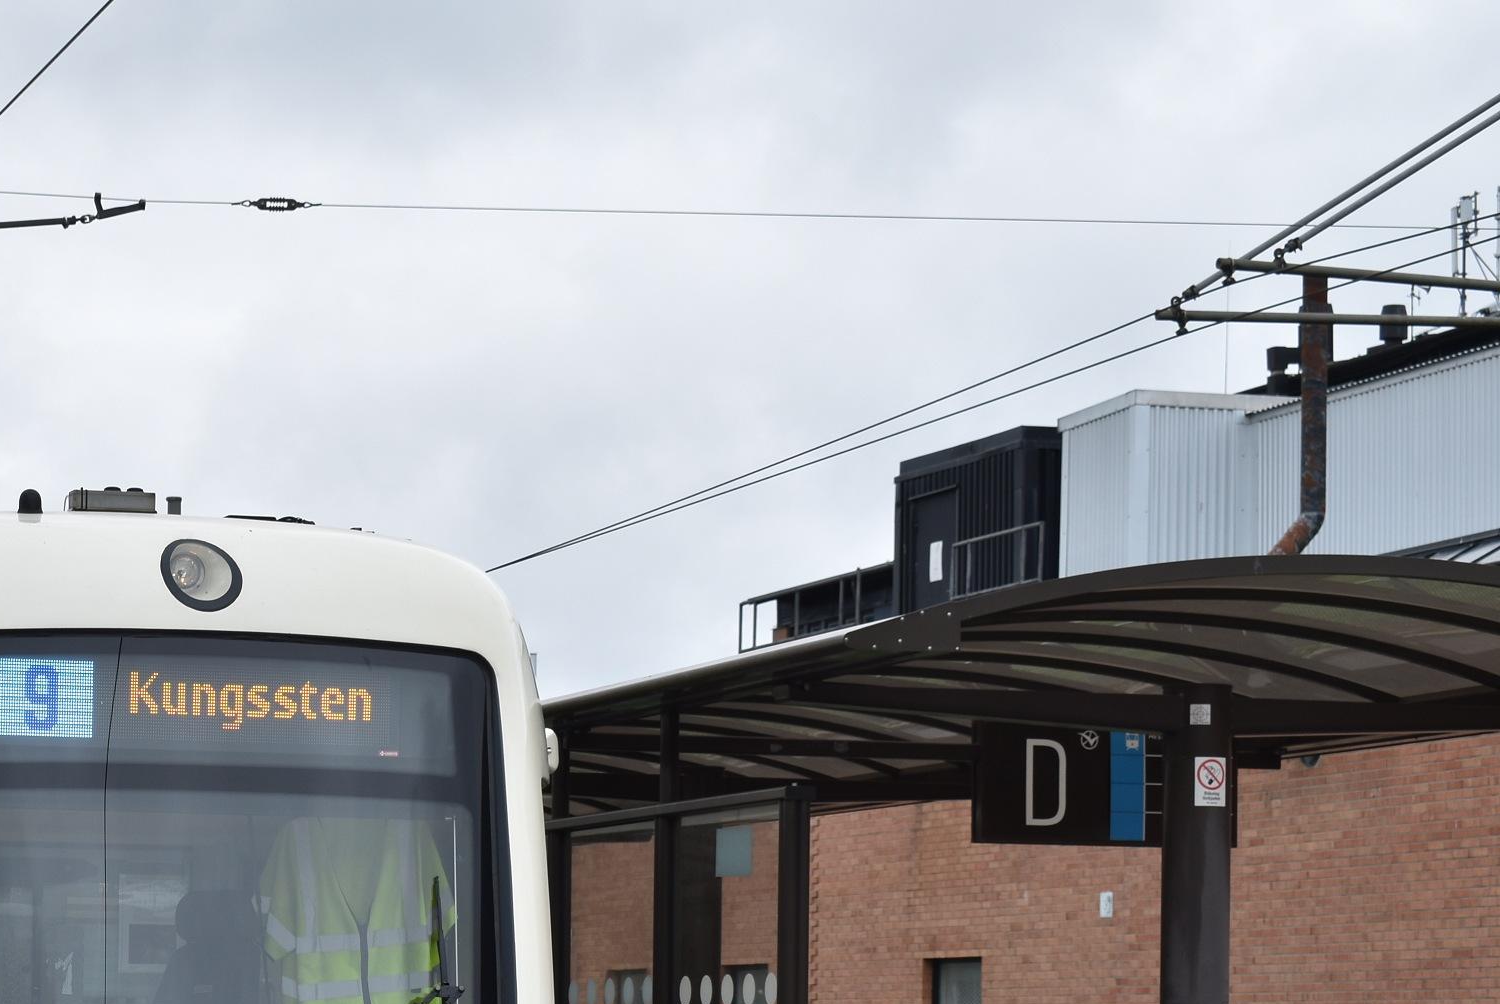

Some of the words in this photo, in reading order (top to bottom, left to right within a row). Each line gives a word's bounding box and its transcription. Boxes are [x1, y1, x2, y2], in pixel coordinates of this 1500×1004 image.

[25, 665, 60, 731] 9
[128, 671, 372, 730] Kungssten
[1025, 738, 1067, 826] D
